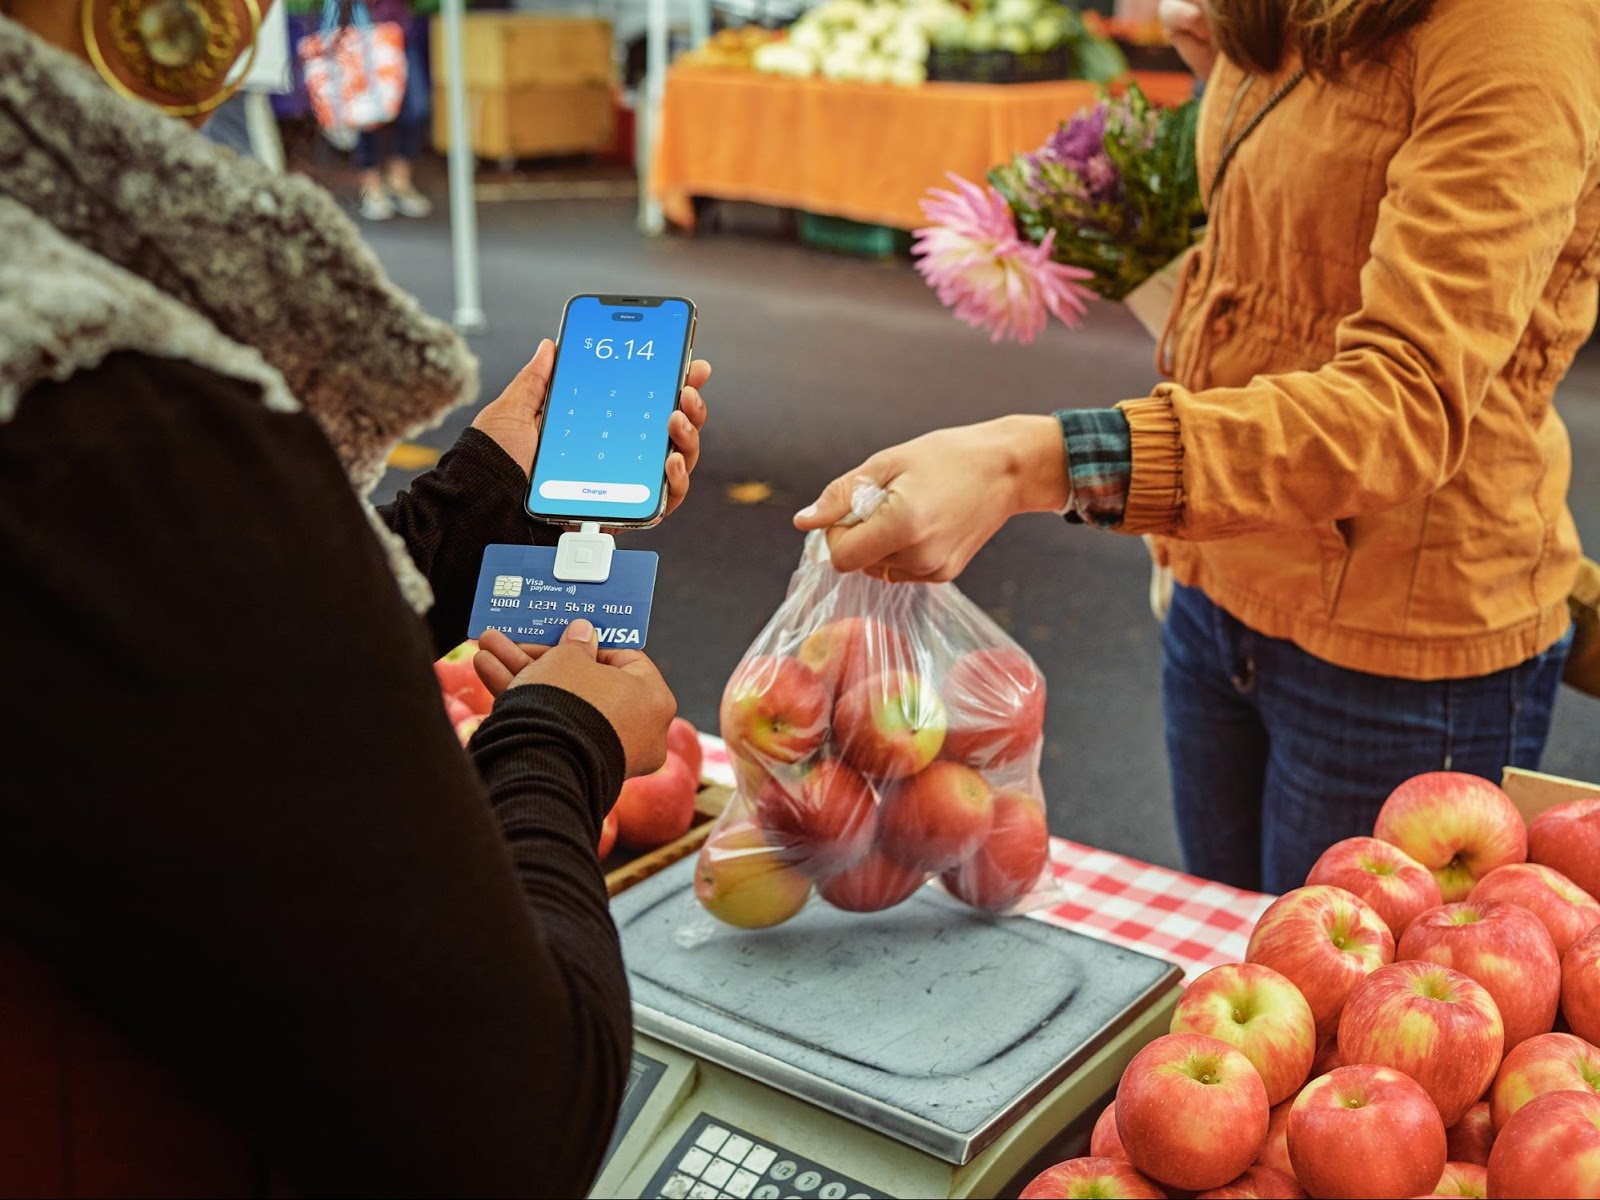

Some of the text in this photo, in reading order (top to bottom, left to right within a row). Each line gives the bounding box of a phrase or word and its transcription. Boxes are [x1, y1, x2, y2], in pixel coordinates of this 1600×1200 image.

[583, 337, 655, 361] $6.14
[573, 388, 654, 399] 1 2 3
[605, 410, 613, 418] 5
[643, 411, 650, 420] 6
[564, 429, 647, 441] 7 8 9
[597, 452, 605, 460] 0
[581, 487, 608, 496] Charge
[525, 578, 544, 586] Visa
[490, 598, 633, 615] 4000 1234 5678 9010
[543, 617, 569, 626] 12/26
[595, 627, 639, 643] VISA
[803, 1176, 812, 1185] 7
[828, 1187, 837, 1197] 8
